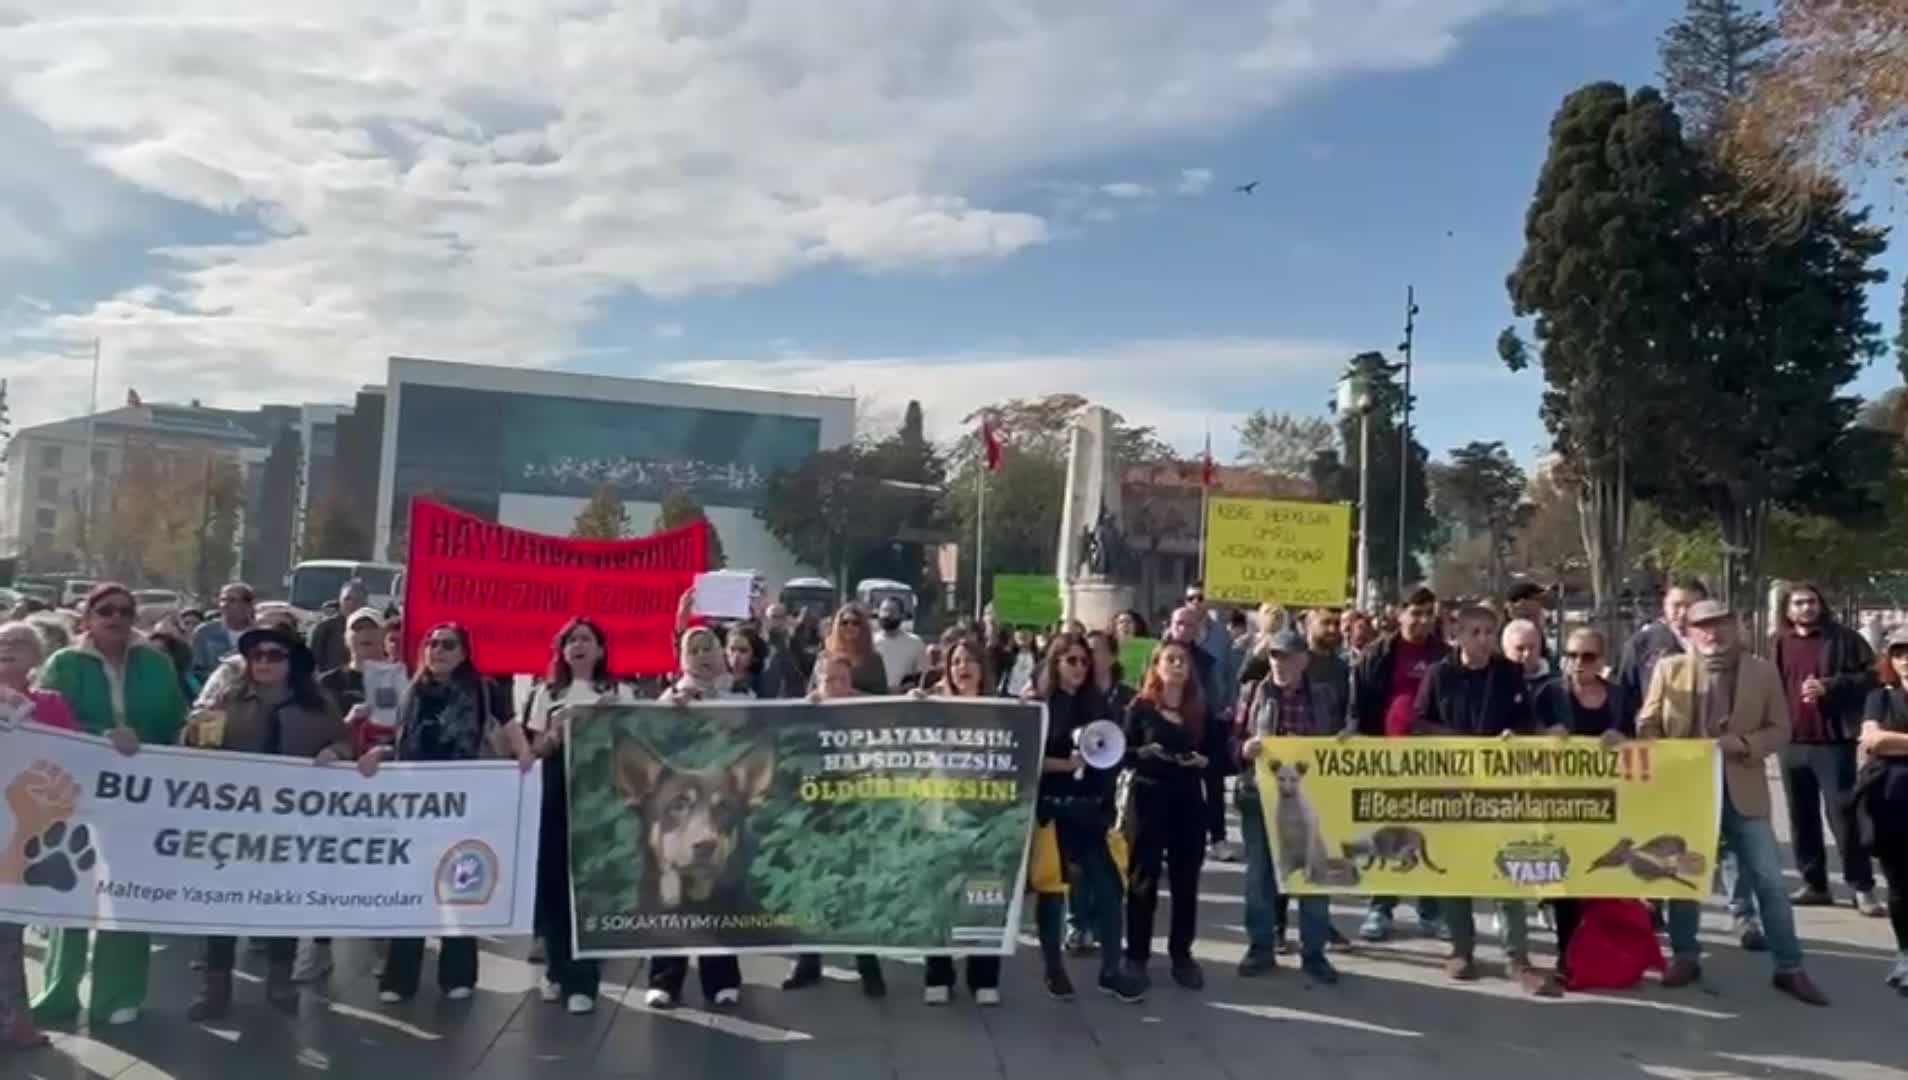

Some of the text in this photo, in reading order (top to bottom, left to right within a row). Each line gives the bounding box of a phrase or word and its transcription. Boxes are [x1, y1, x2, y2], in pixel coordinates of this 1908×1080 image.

[1314, 748, 1475, 777] YASAKLARINIZI
[95, 770, 468, 819] BU YASA SOKAKTAN
[153, 828, 412, 869] GEÇMEYECEK
[1504, 860, 1562, 882] YASA
[95, 880, 423, 907] Maltepe Yaşam Hakkı Savunucuları
